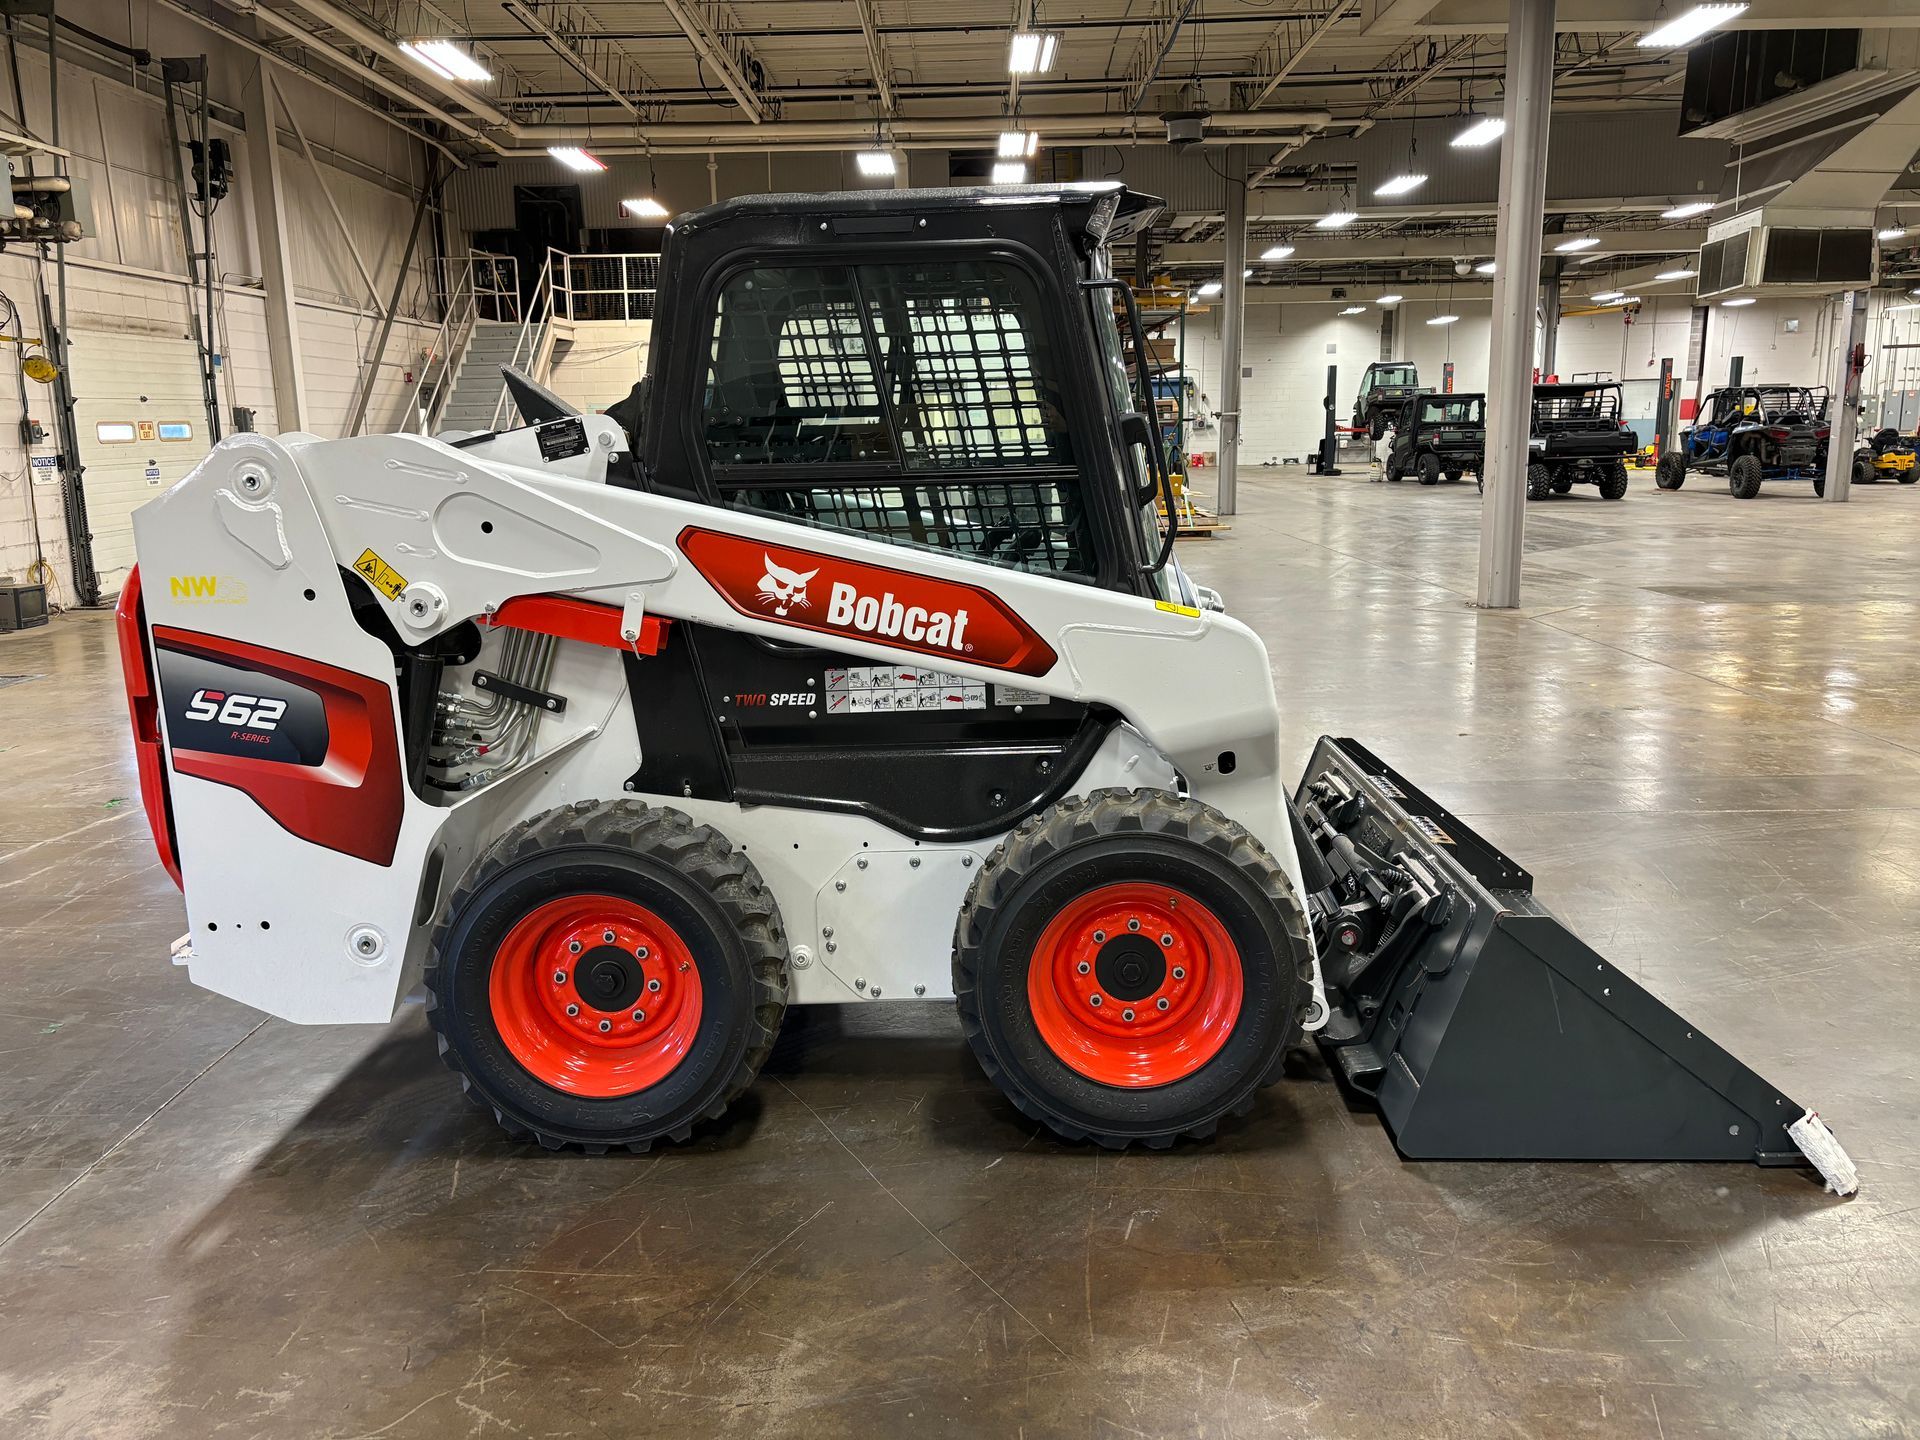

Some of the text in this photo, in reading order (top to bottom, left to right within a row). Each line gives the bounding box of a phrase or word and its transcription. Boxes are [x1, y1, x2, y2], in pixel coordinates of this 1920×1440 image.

[32, 458, 55, 466] NOTICE
[170, 576, 216, 597] NW
[826, 582, 968, 650] Bobcat
[735, 692, 816, 707] TWO SPEED
[184, 689, 288, 730] S62
[230, 731, 271, 744] R-SERIES
